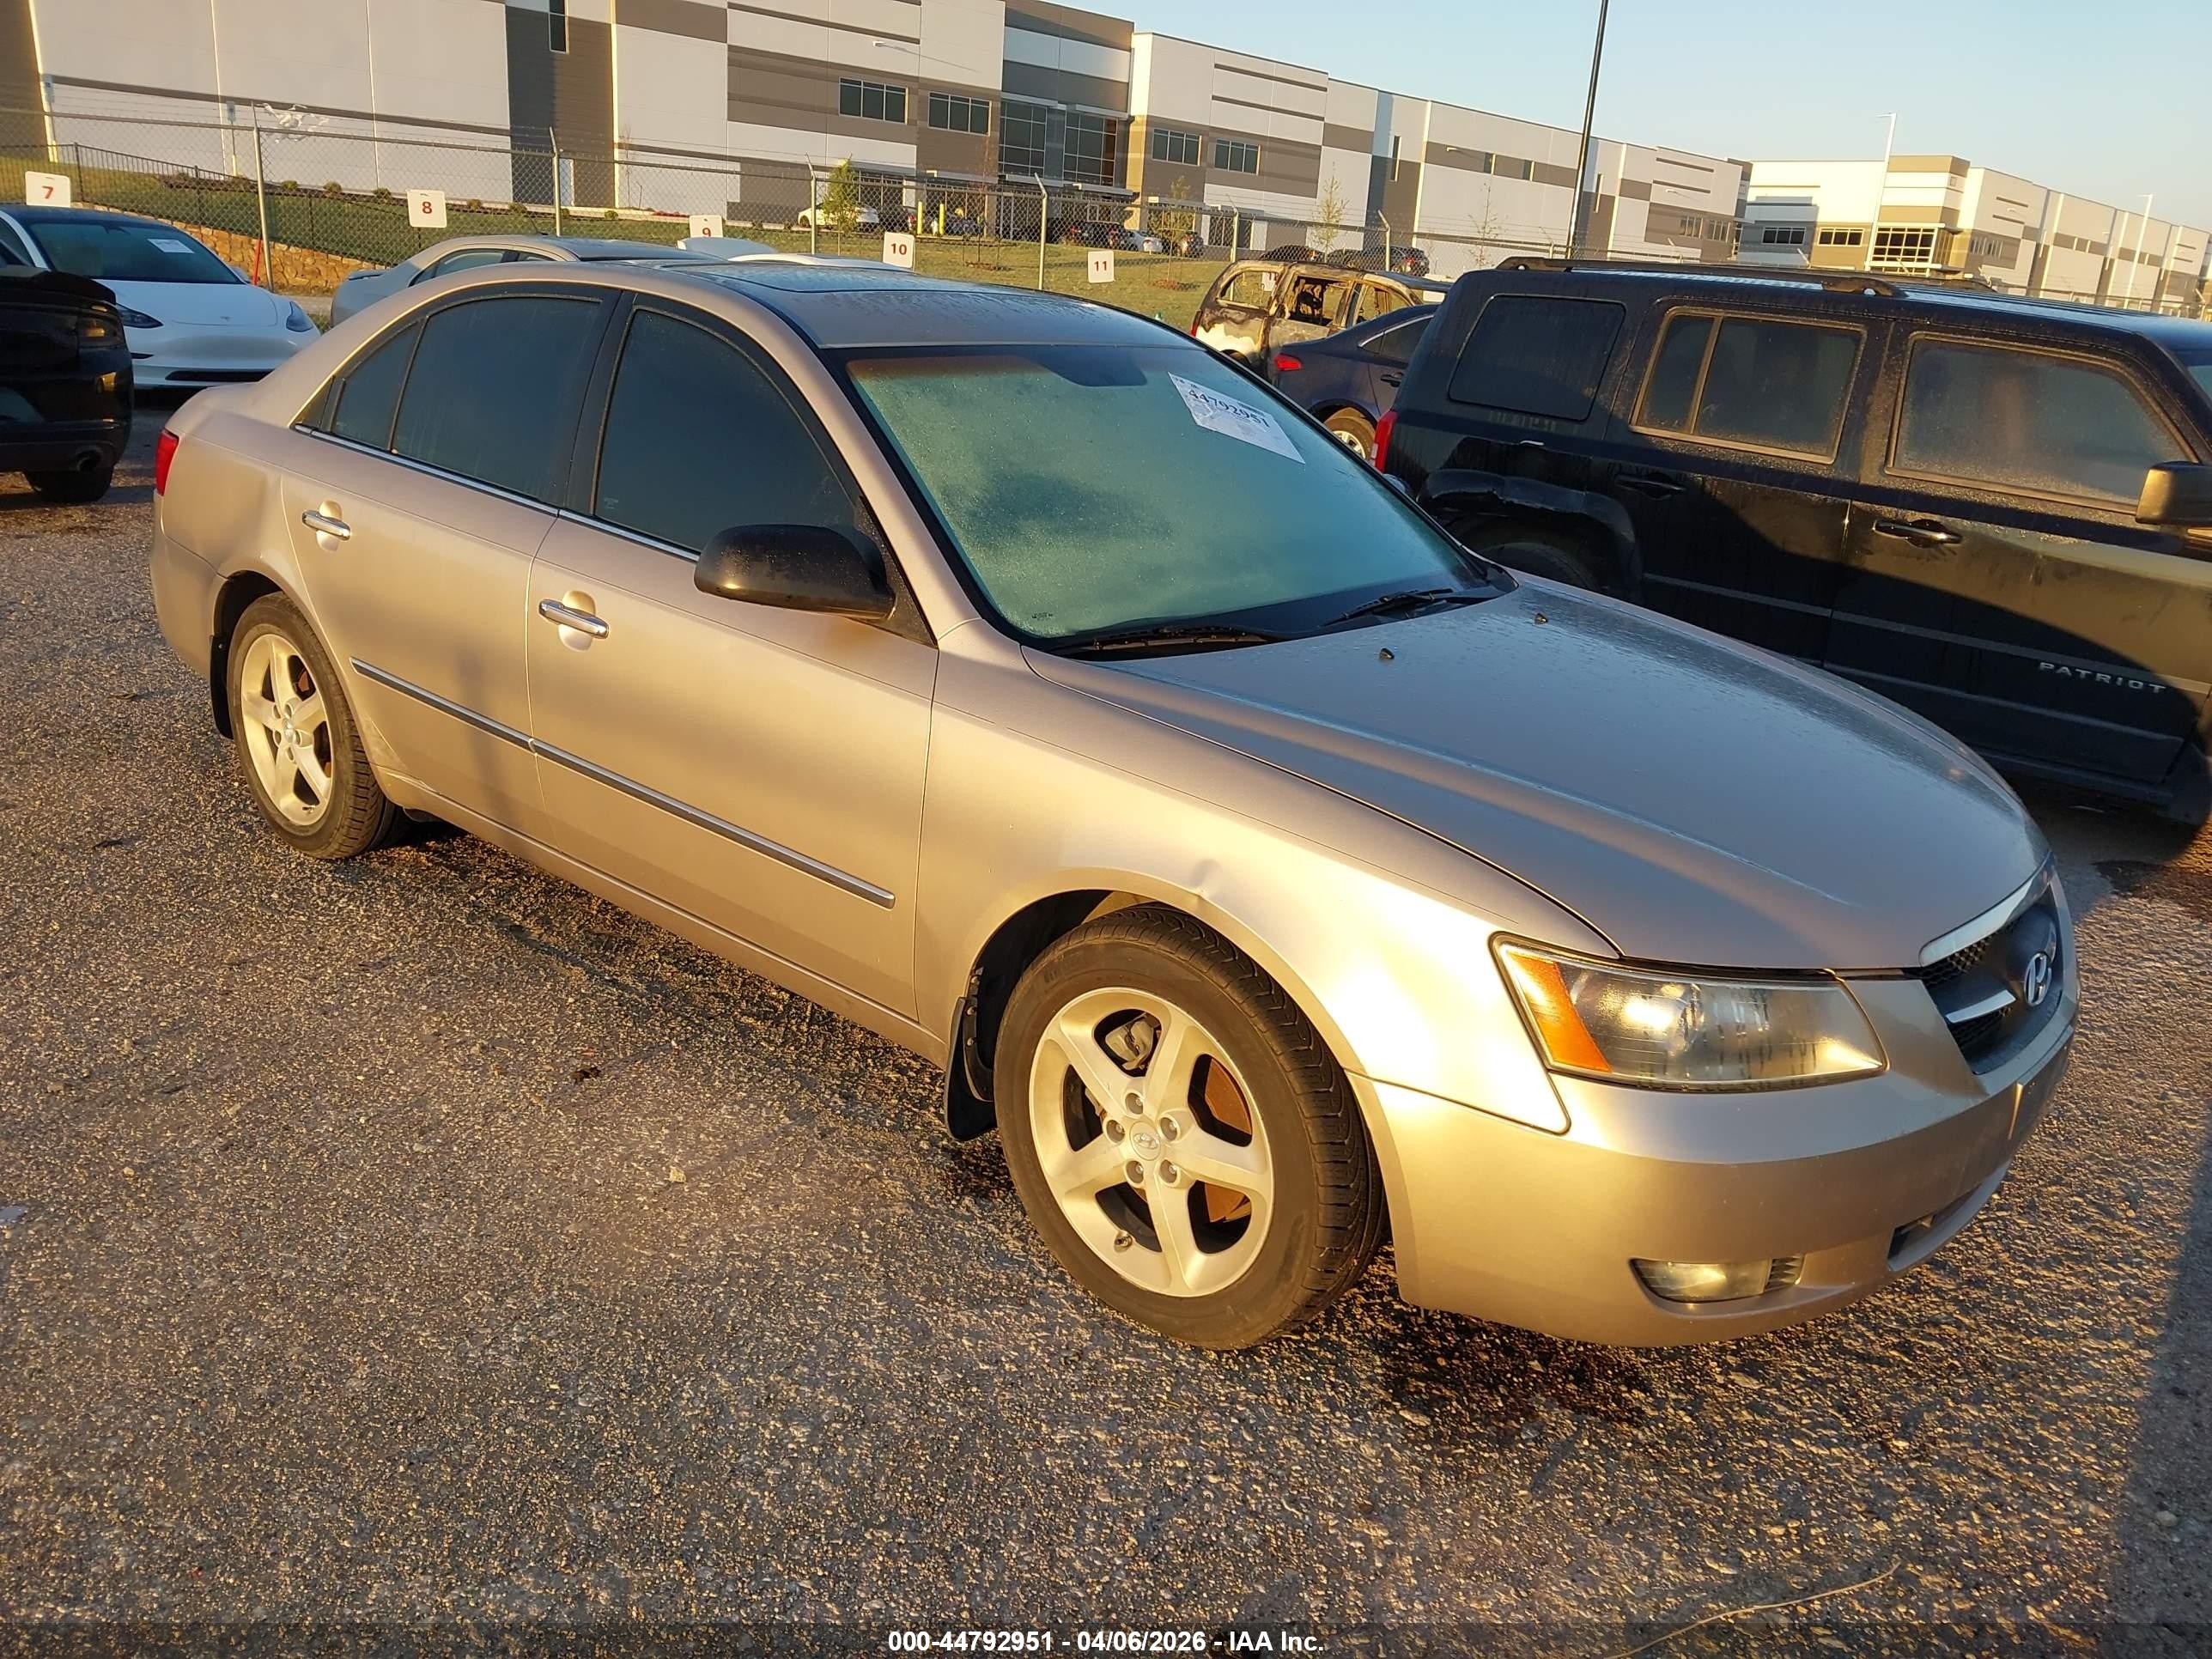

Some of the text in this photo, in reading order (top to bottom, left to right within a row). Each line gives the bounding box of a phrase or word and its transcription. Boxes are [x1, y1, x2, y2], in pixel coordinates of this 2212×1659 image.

[41, 185, 54, 199] 7
[422, 201, 433, 214] 8
[890, 242, 908, 256] 10
[1093, 260, 1108, 272] 11
[1188, 389, 1271, 428] 44792951
[2039, 661, 2166, 694] PATRIOT
